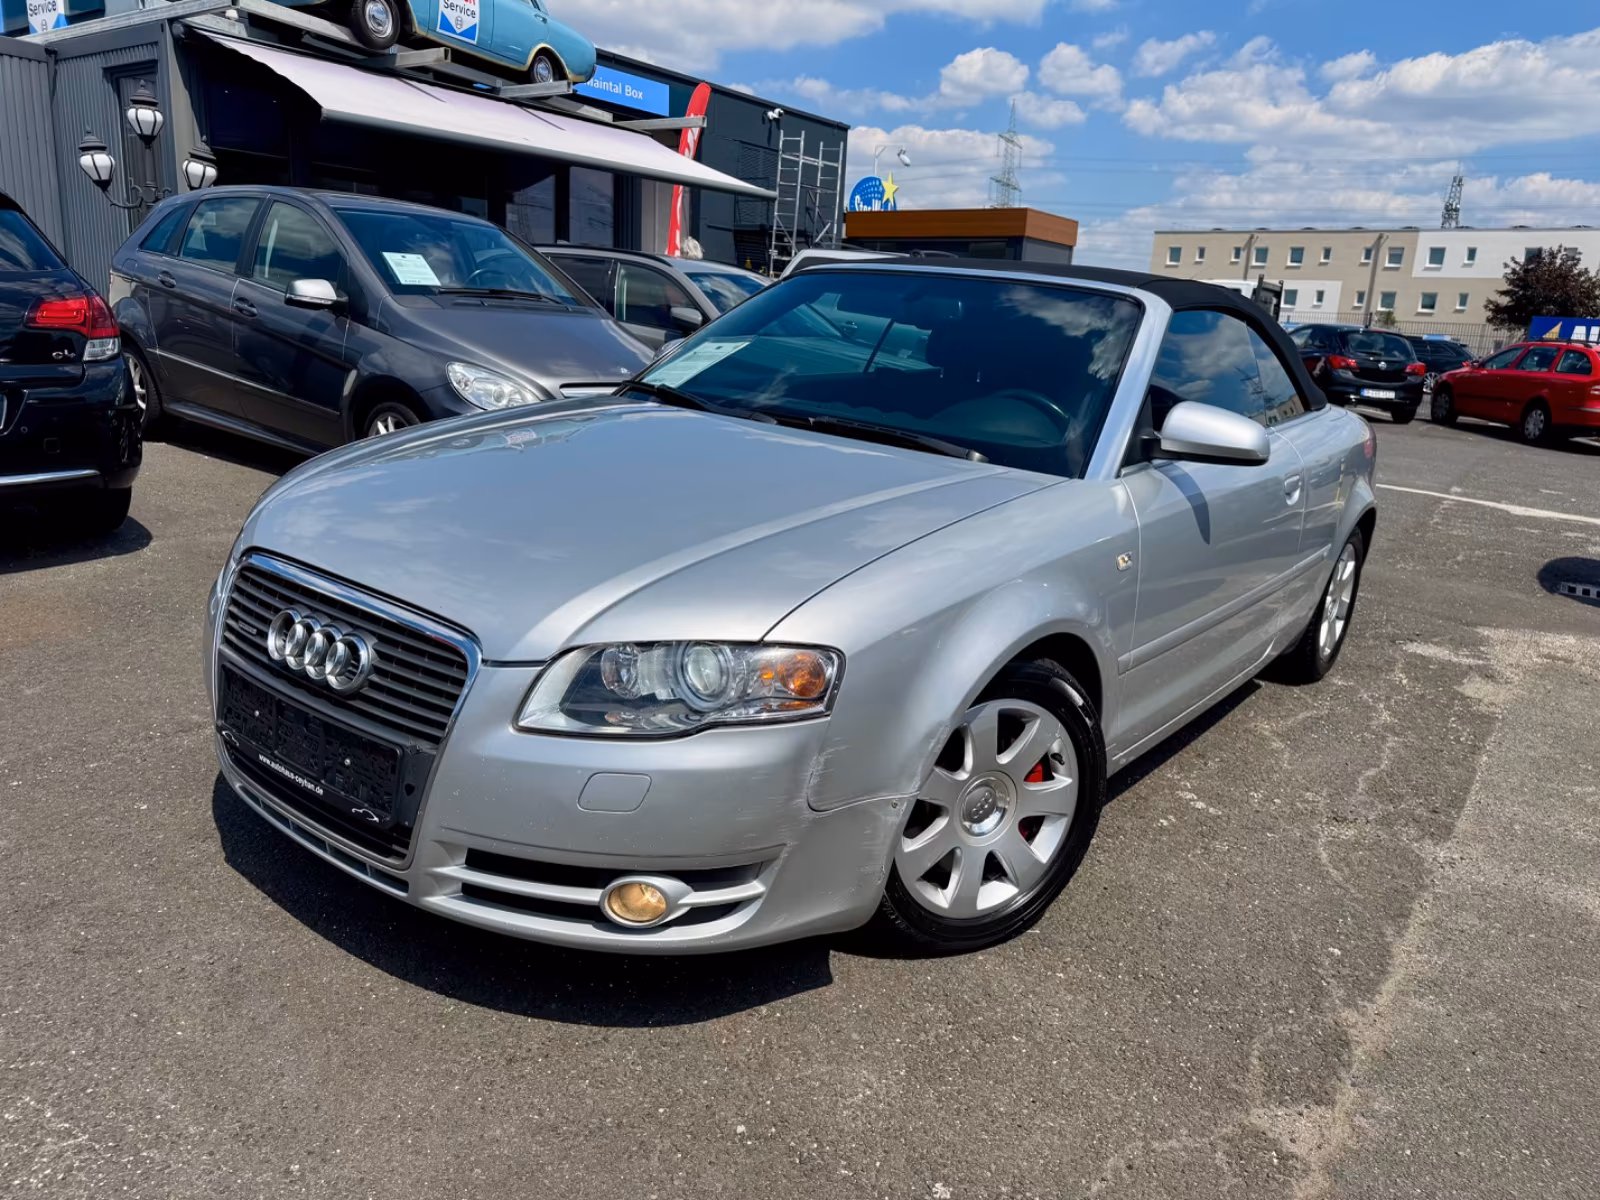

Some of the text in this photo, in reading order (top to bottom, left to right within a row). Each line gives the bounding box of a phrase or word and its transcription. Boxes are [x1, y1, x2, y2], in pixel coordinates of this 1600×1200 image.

[28, 0, 57, 17] Service
[443, 0, 476, 19] Service
[625, 84, 643, 100] Box
